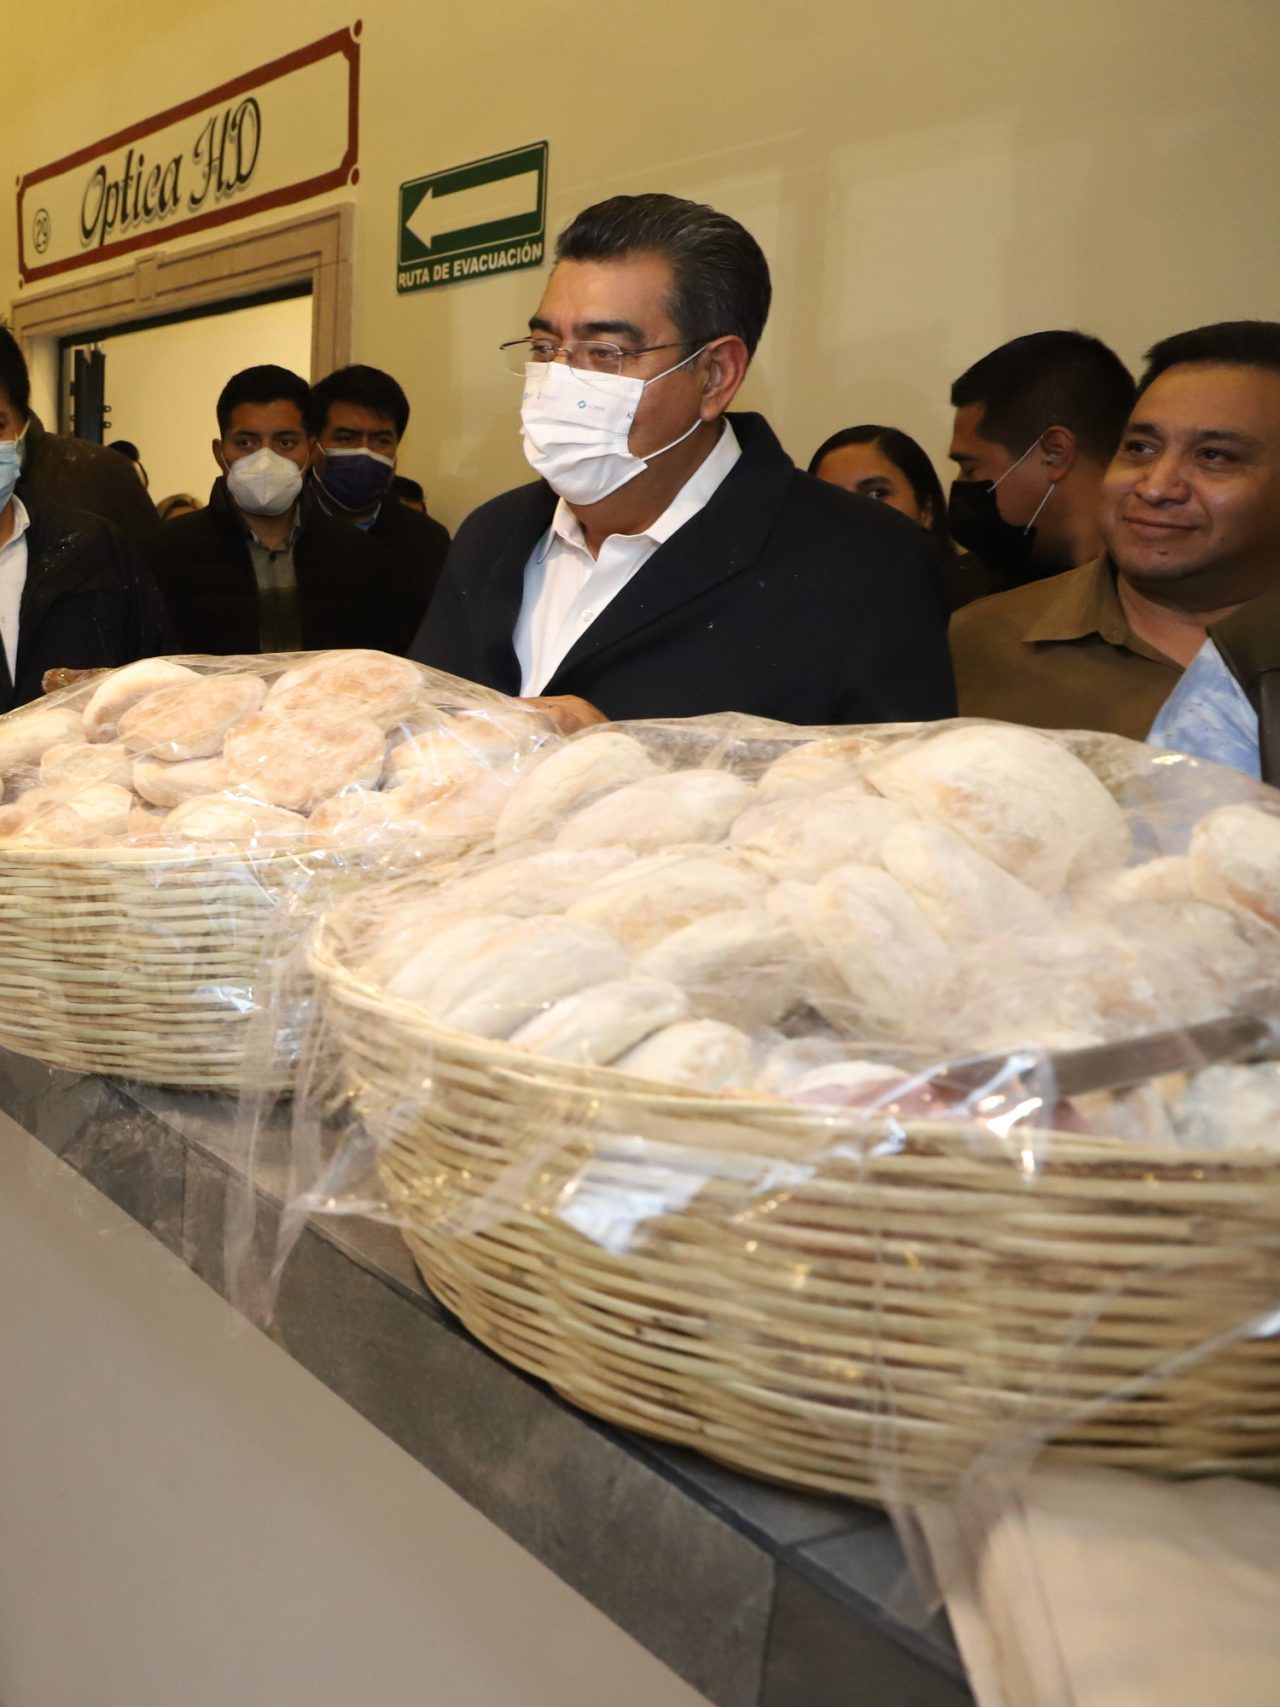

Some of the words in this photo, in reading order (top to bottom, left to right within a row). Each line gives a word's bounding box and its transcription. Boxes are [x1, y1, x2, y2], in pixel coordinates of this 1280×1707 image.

[81, 149, 183, 247] Optica
[189, 96, 262, 206] HD
[398, 267, 430, 289] RUTA
[433, 263, 450, 281] DE
[453, 241, 542, 277] EVACUACIÓN
